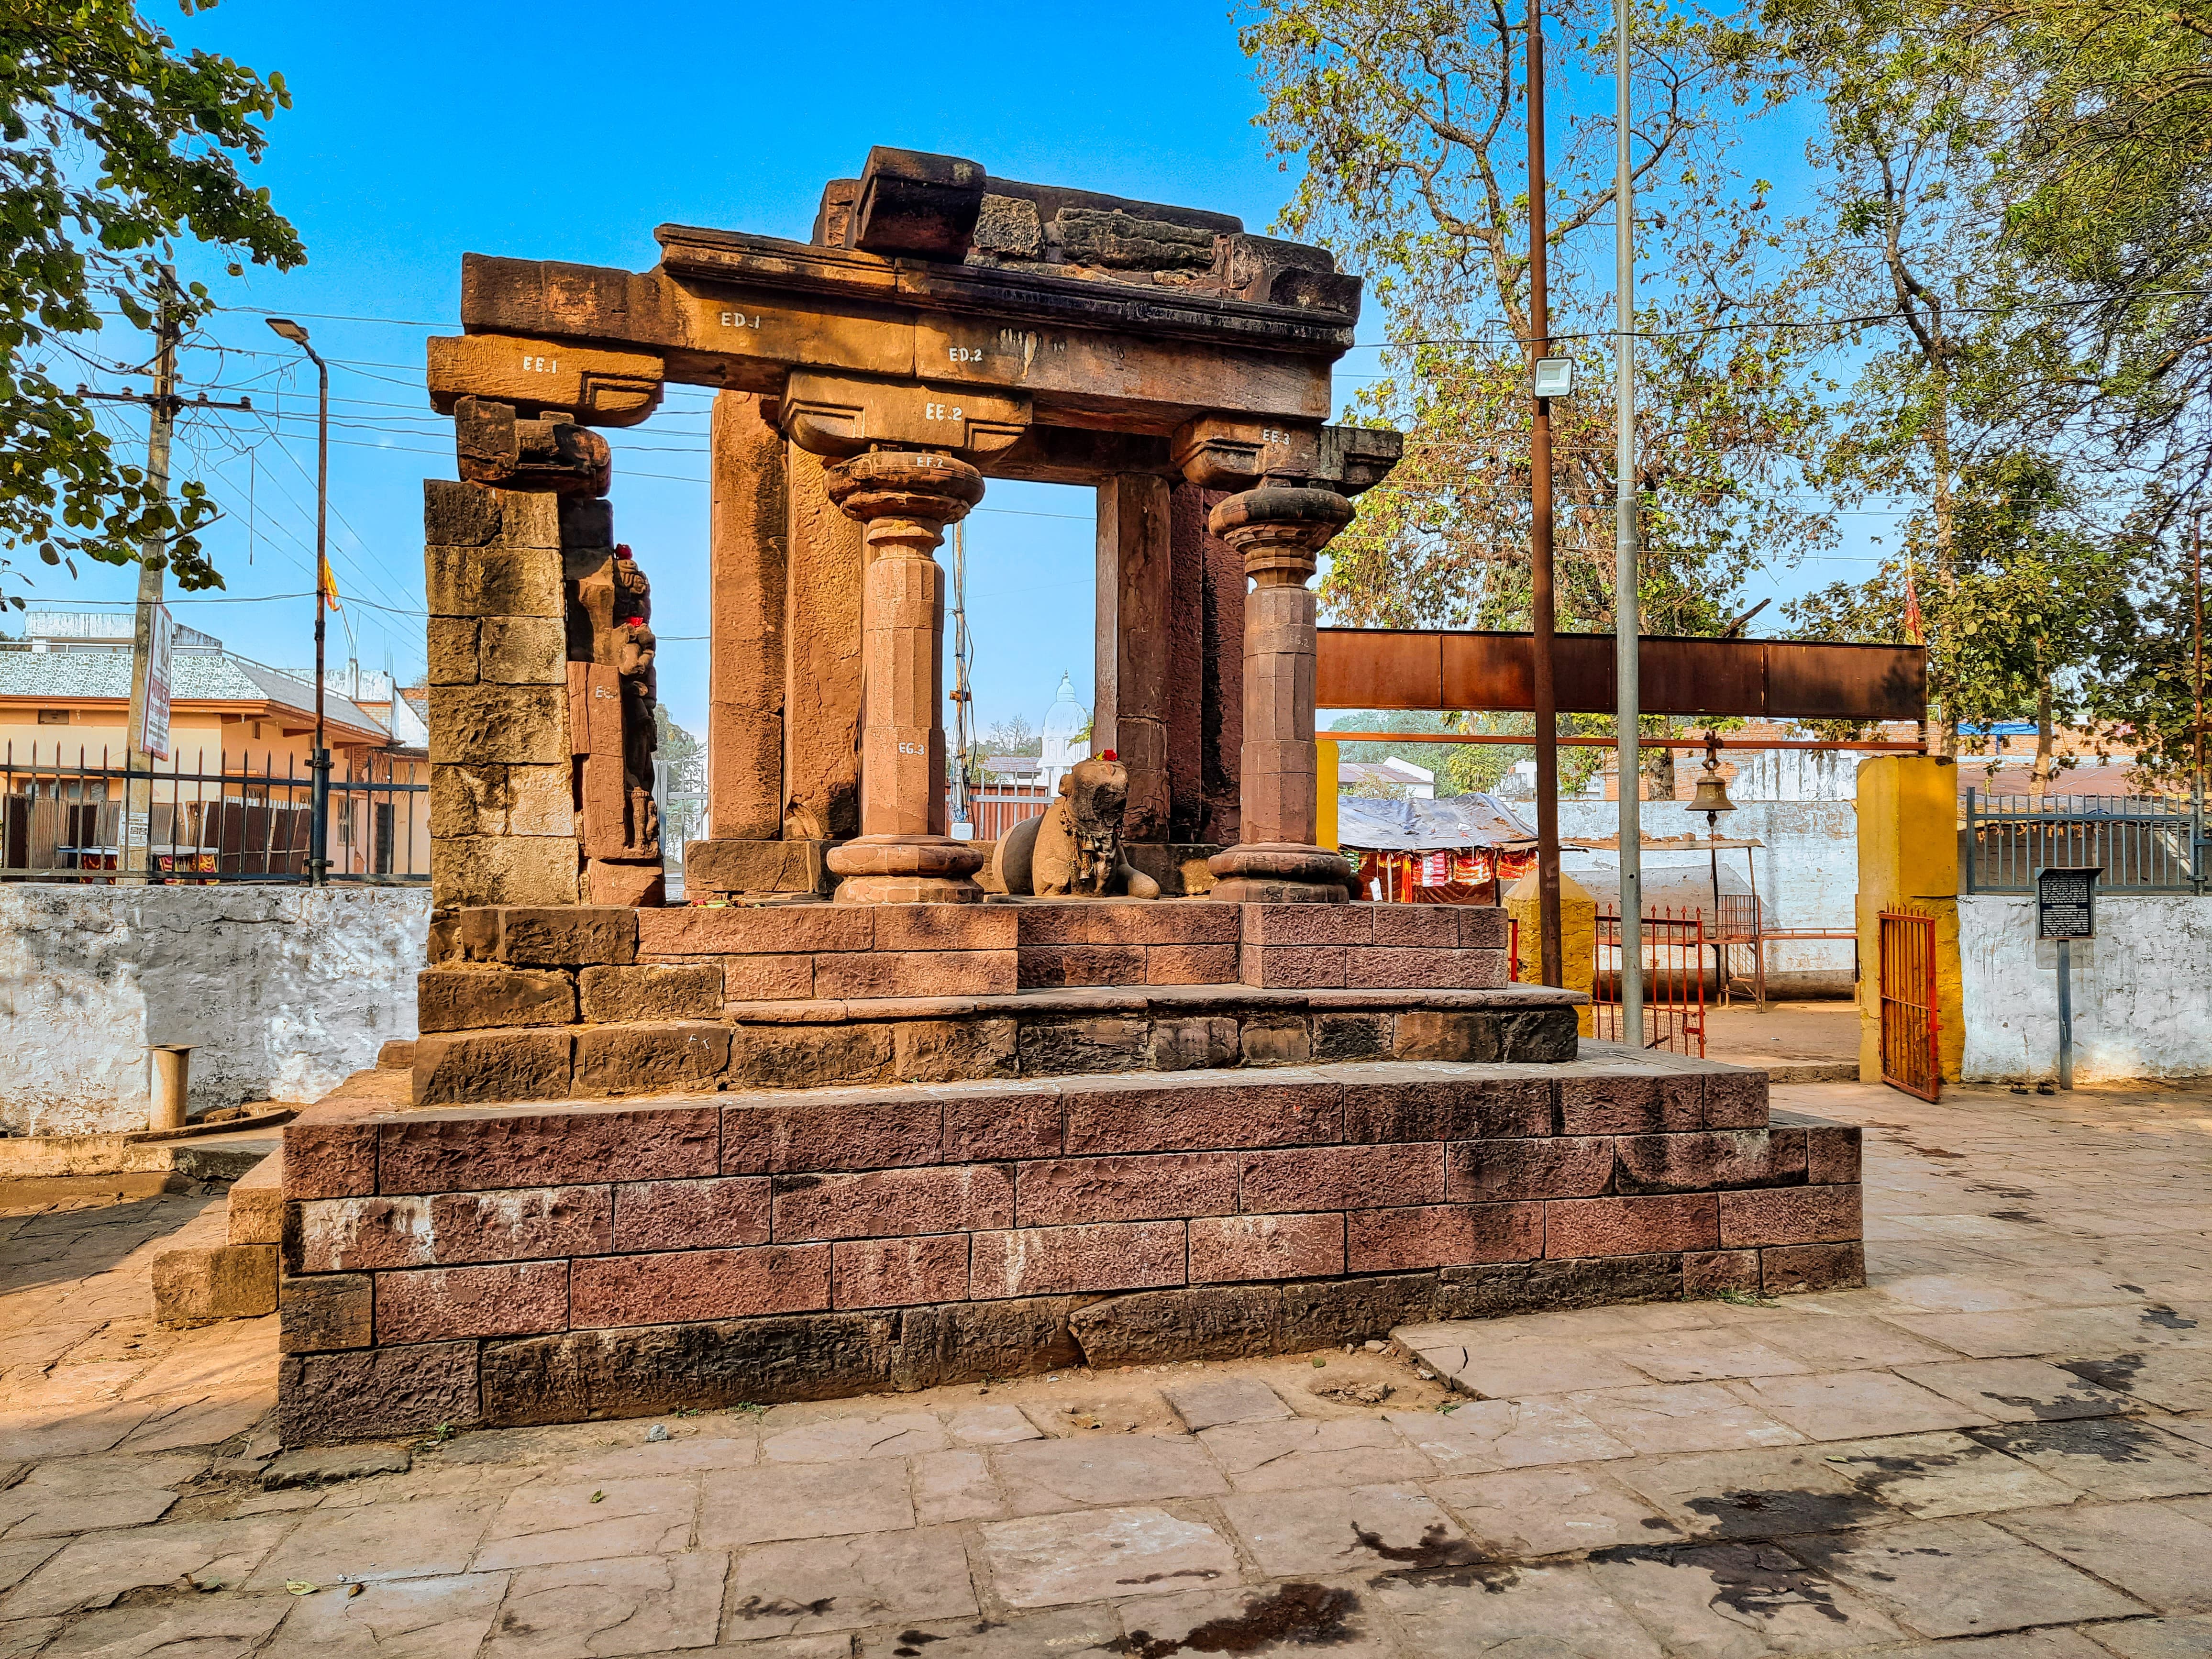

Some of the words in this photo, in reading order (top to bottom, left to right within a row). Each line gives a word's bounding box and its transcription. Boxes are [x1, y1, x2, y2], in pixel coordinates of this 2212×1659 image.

[949, 347, 983, 362] ED.2
[926, 402, 962, 422] EE.2
[917, 456, 943, 467] EF.2
